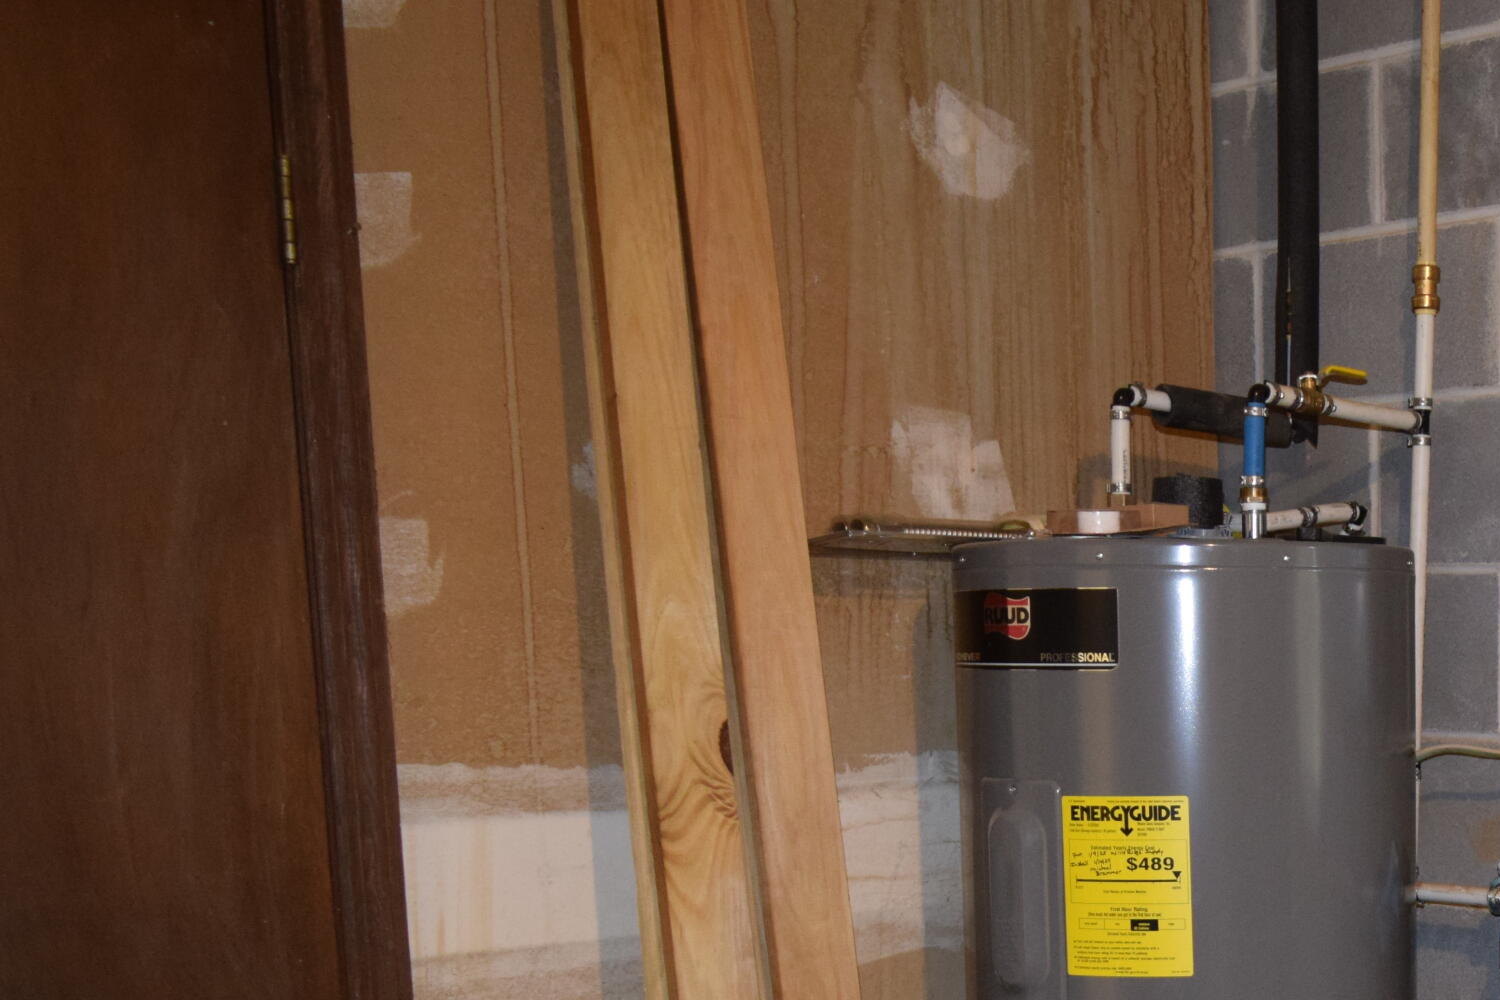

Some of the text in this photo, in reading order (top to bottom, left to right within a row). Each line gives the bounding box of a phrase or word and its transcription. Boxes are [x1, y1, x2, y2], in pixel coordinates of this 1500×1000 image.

[985, 607, 1029, 624] RUUD
[1040, 651, 1115, 663] PROFESSIONAL
[1070, 805, 1182, 822] ENERGYGUIDE
[1126, 857, 1175, 872] $489
